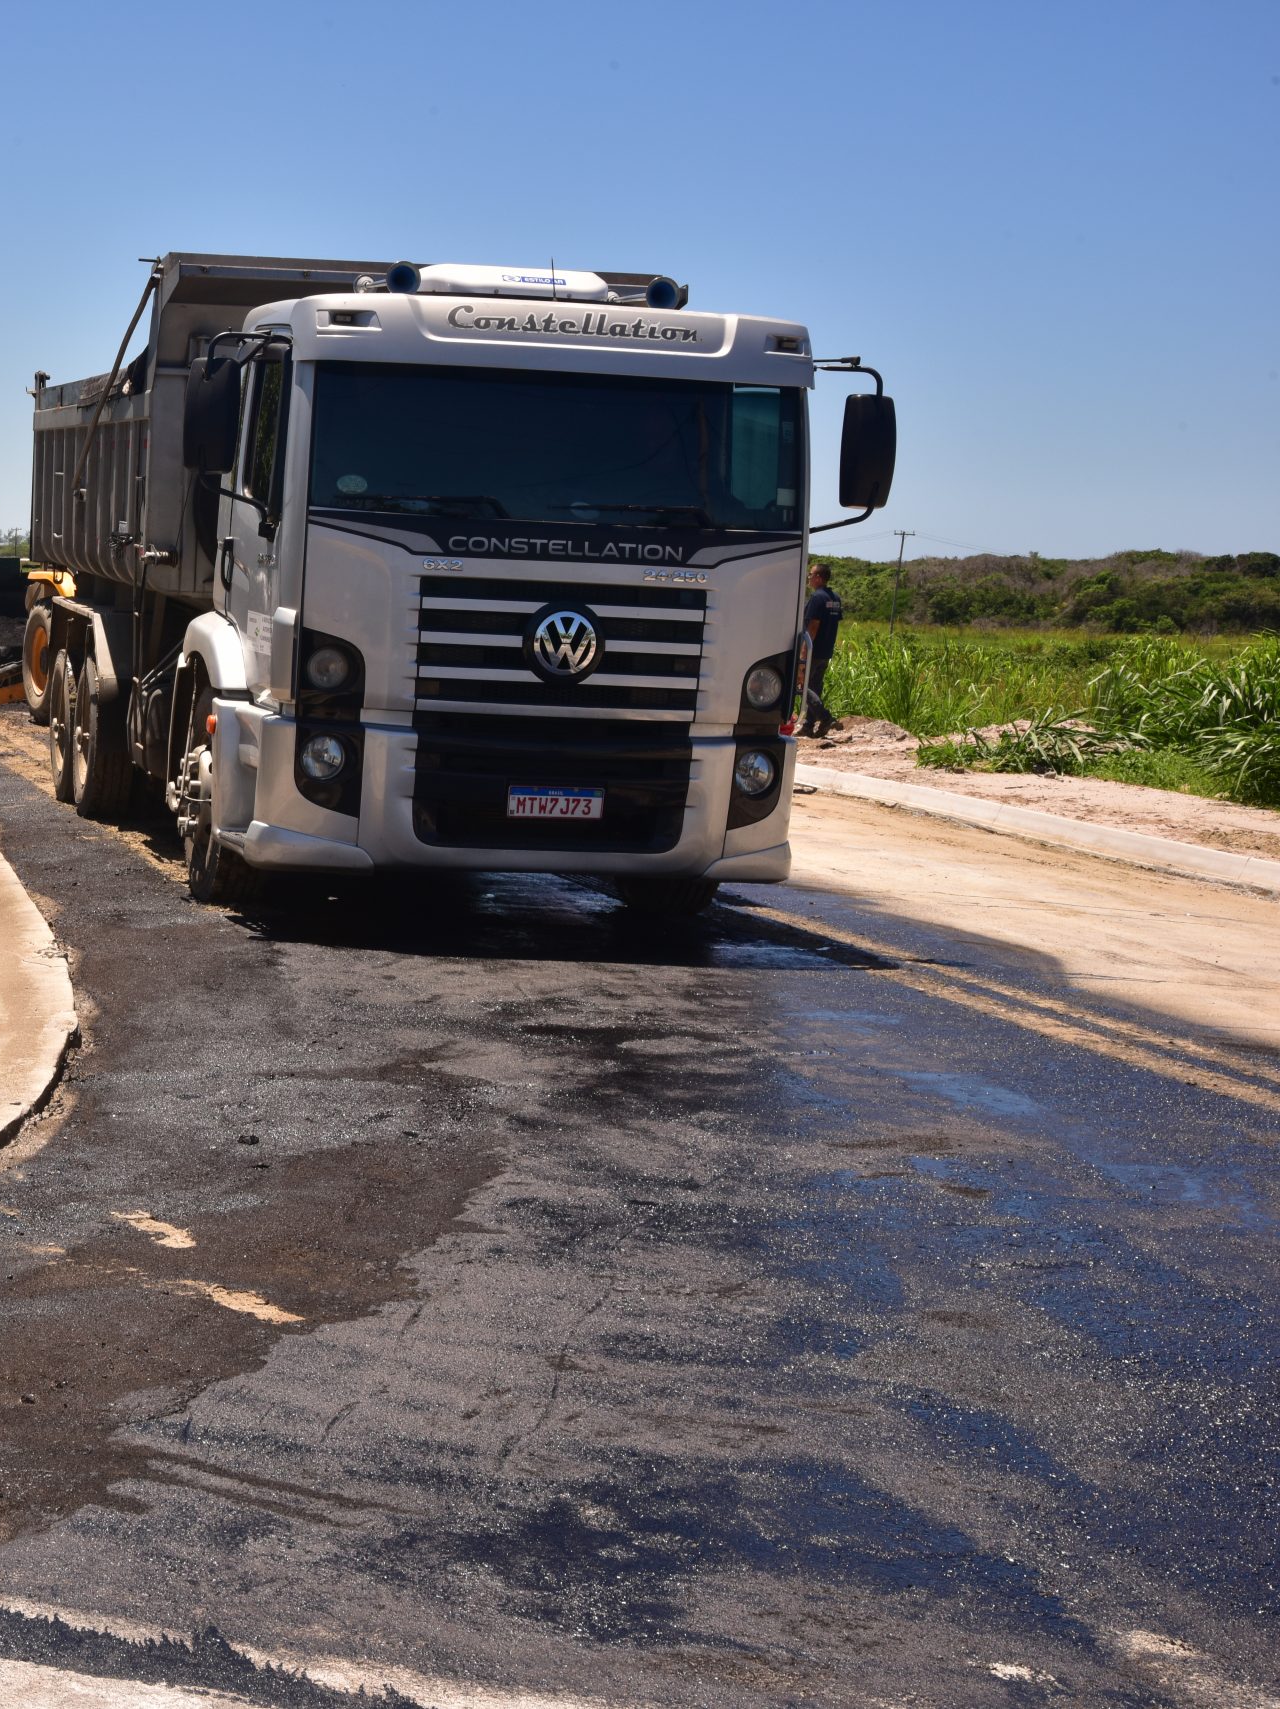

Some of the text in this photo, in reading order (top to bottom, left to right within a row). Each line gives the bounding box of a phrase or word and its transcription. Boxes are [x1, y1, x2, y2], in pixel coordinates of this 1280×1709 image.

[447, 305, 698, 342] Constellation
[448, 536, 683, 561] CONSTELLATION
[516, 797, 592, 815] MTW7J73
